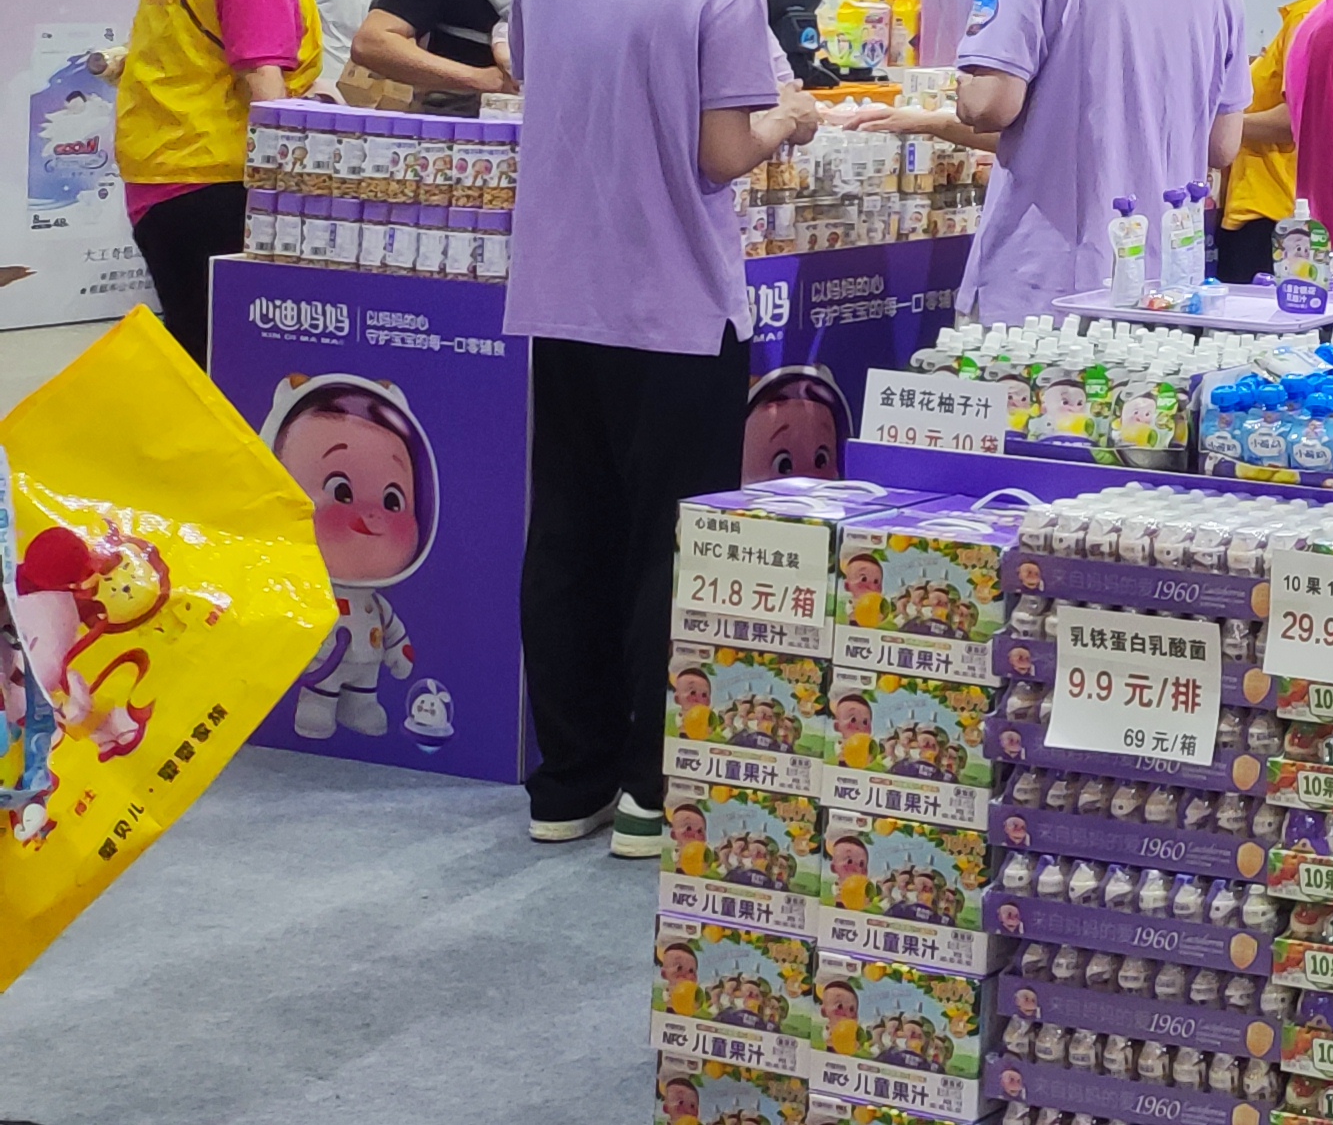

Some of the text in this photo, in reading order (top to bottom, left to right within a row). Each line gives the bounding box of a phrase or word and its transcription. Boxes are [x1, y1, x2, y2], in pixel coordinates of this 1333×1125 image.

[249, 296, 350, 335] 心迪妈妈
[879, 386, 993, 419] 金银花柚子汁
[924, 429, 944, 448] 元
[952, 433, 974, 451] 10
[694, 517, 741, 535] 心迪妈妈
[693, 541, 801, 569] NFC 果汁礼盒装
[691, 575, 817, 619] 21.8 元/箱
[1153, 580, 1200, 603] 1960
[1282, 575, 1301, 592] 10
[1306, 576, 1323, 596] 果
[713, 619, 788, 646] 儿童果汁
[1070, 626, 1207, 662] 乳铁蛋白乳酸菌
[876, 645, 954, 674] 儿童果汁
[1068, 667, 1202, 715] 9.9 元/排
[1123, 728, 1198, 757] 69 元/箱
[705, 757, 779, 786] 儿童果汁
[864, 785, 942, 815] 儿童果汁
[1138, 837, 1186, 862] 1960
[701, 892, 774, 923] 儿童果汁
[862, 928, 940, 960] 儿童果汁
[1132, 926, 1179, 951] 1960
[1149, 1012, 1195, 1037] 1960
[692, 1033, 765, 1065] 儿童果汁
[854, 1075, 930, 1105] 儿童果汁
[1134, 1094, 1181, 1120] 1960
